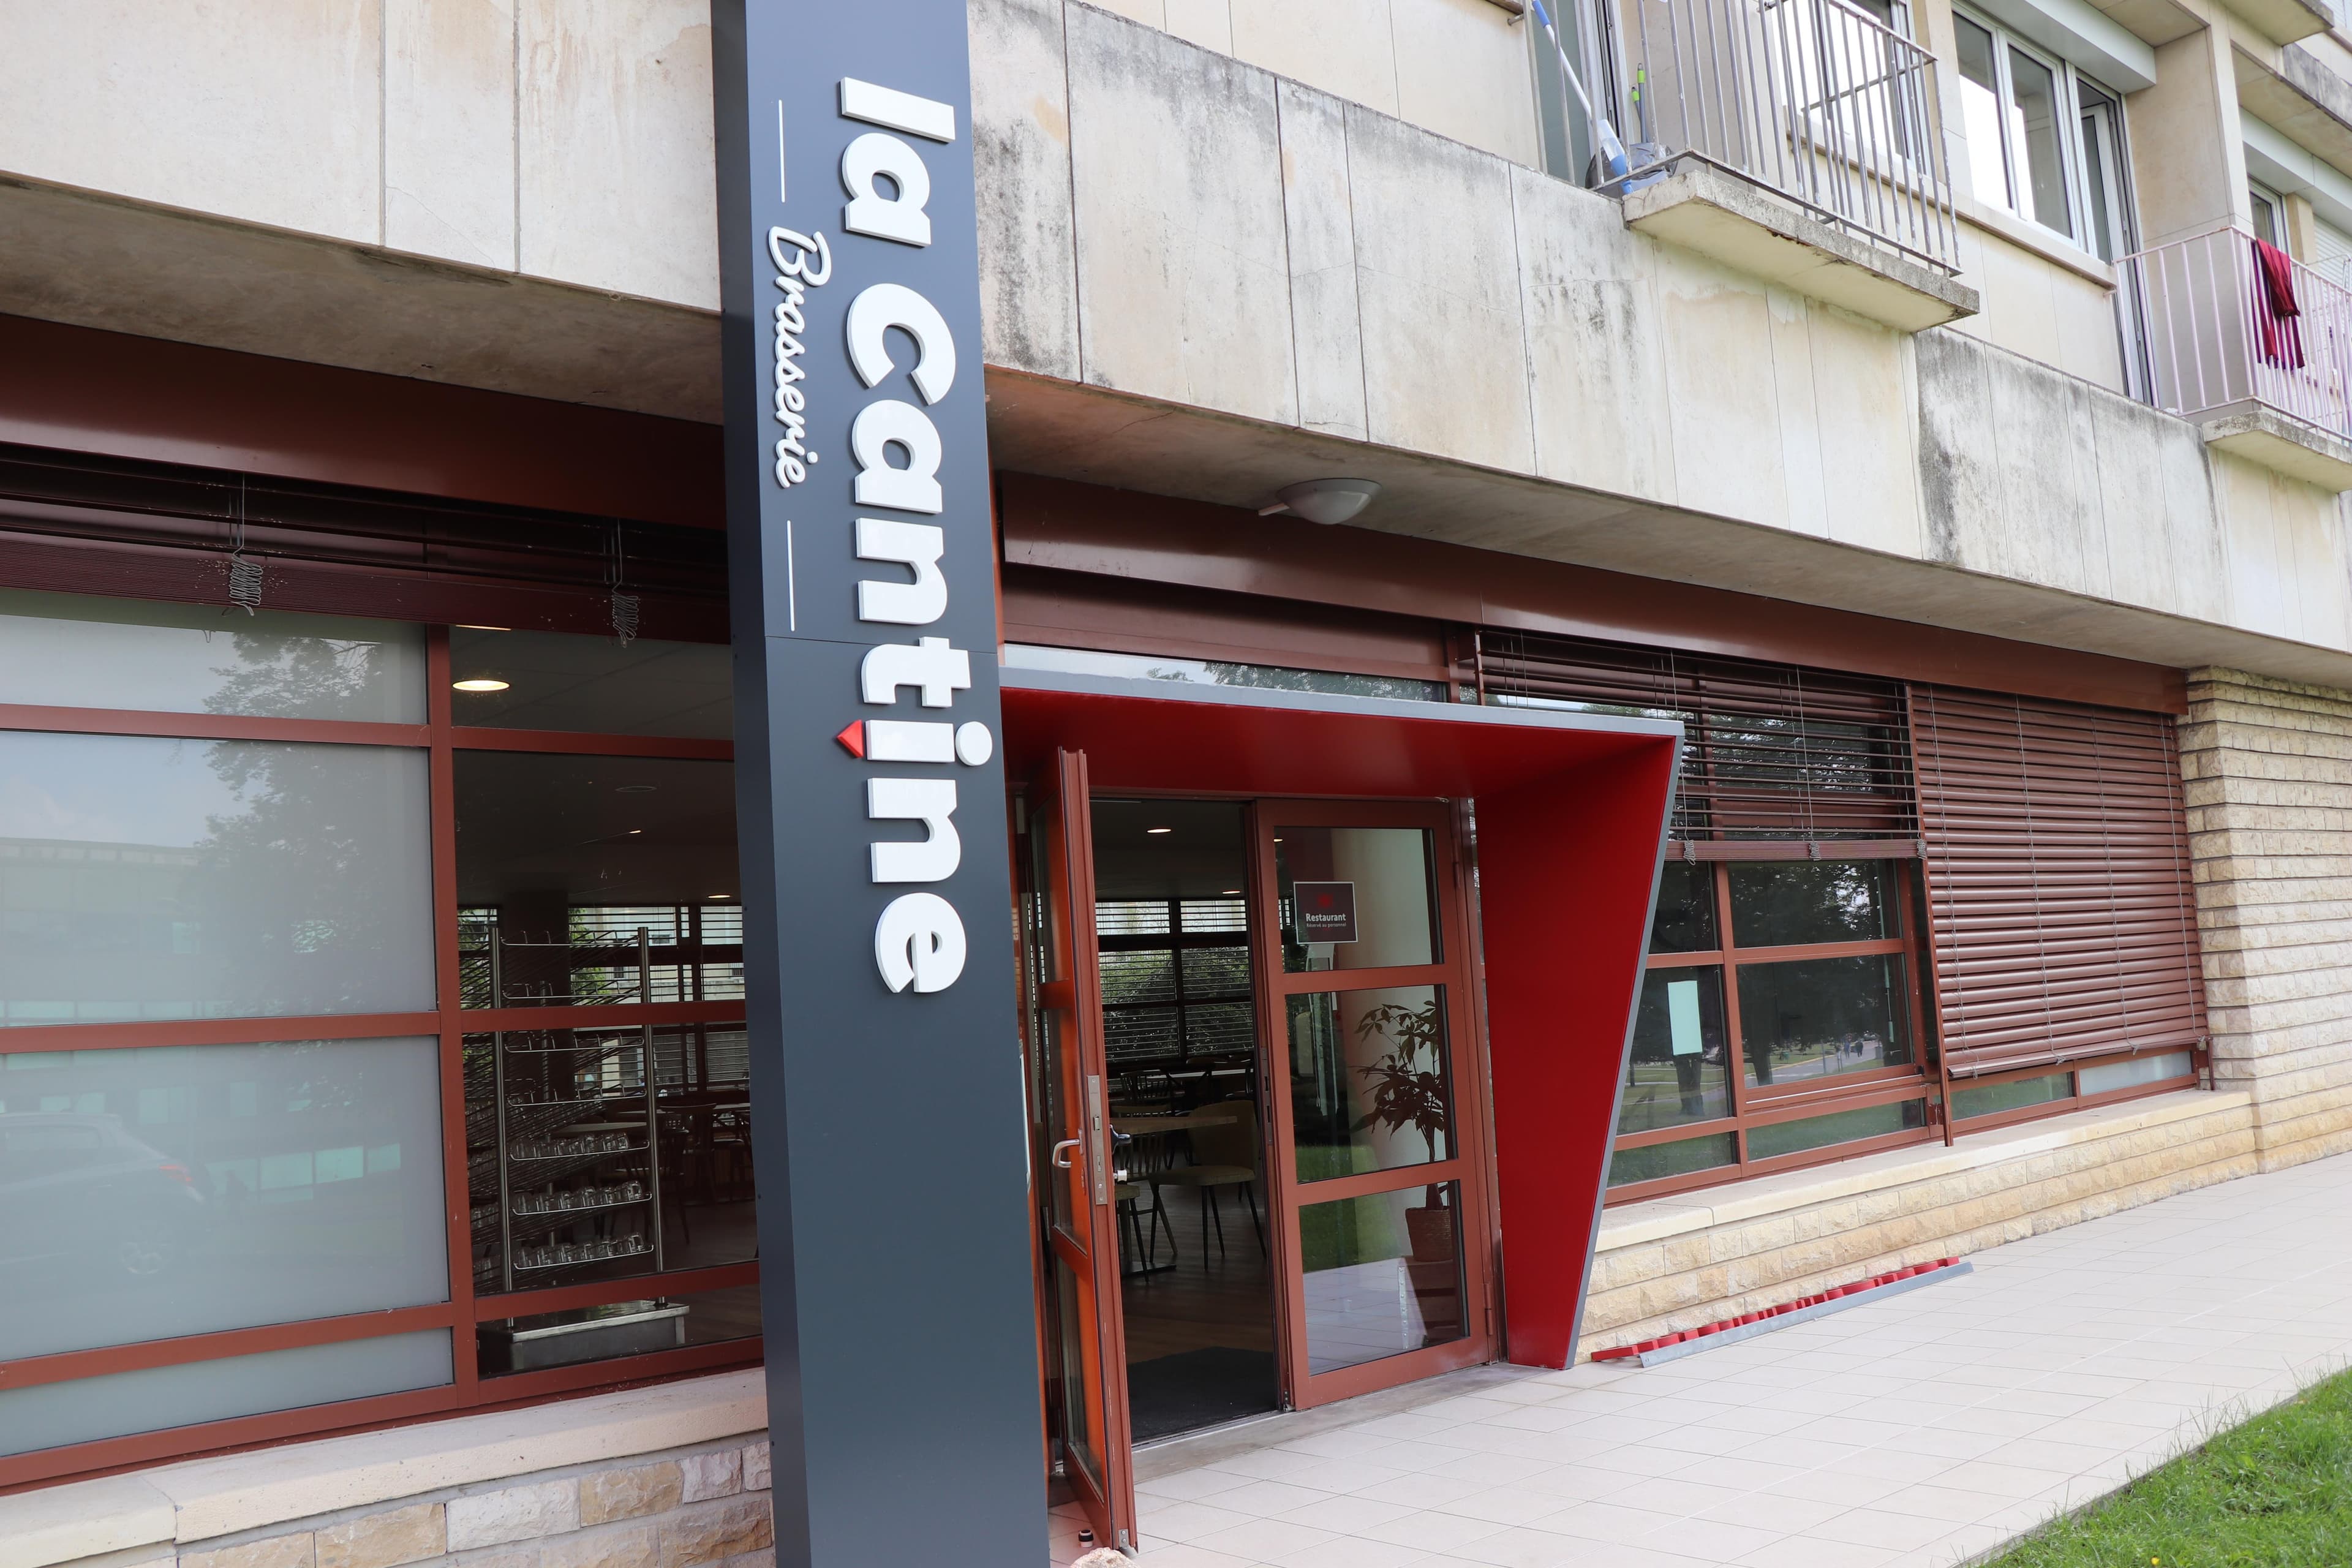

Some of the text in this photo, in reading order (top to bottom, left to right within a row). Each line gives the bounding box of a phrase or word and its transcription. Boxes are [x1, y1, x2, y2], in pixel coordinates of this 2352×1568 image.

[767, 225, 832, 489] Brasserie
[838, 76, 993, 995] la Cantine
[1306, 913, 1346, 922] Restaurant
